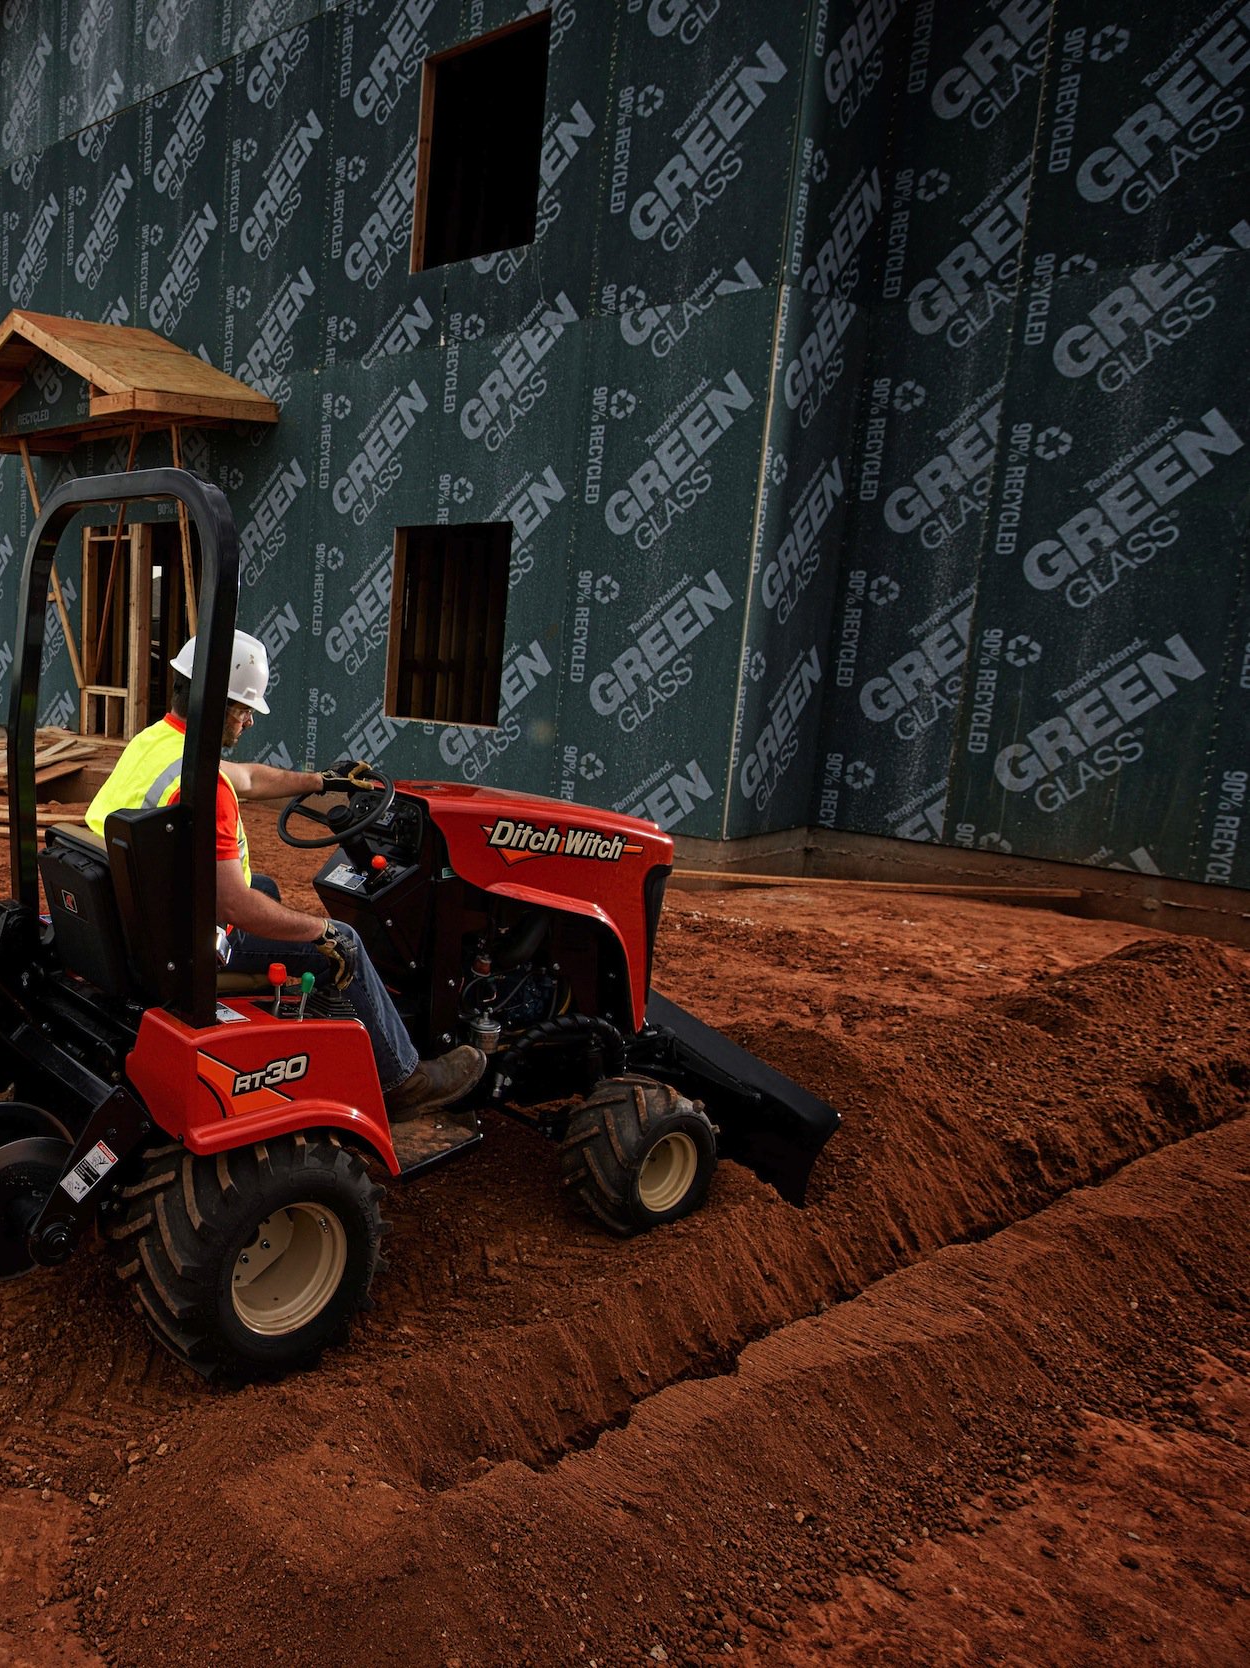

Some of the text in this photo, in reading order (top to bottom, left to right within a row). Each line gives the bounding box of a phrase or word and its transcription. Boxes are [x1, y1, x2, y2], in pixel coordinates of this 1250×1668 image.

[264, 27, 309, 110] GLASS
[340, 25, 354, 98] RECYCLED
[1049, 27, 1087, 174] 90% RECYCLED
[168, 127, 205, 200] GLASS
[229, 138, 241, 233] 90% RECYCLED
[240, 109, 324, 253] GREEN
[610, 86, 635, 214] 90% RECYCLED
[629, 40, 788, 241] GREEN
[1121, 94, 1245, 215] GLASS
[10, 193, 61, 303] GREEN
[74, 164, 134, 284] GREEN
[258, 185, 302, 261] GLASS
[331, 156, 346, 259] 90% RECYCLED
[661, 149, 743, 252] GLASS
[791, 137, 814, 276] 90% RECYCLED
[882, 168, 915, 299] 90% RECYCLED
[140, 250, 149, 310] RECYCLED
[149, 203, 218, 329] GREEN
[163, 268, 200, 337] GLASS
[327, 316, 338, 350] 90%
[459, 291, 580, 441] GREEN
[1096, 286, 1217, 393] GLASS
[16, 409, 50, 427] RECYCLED
[319, 393, 333, 489] 90% RECYCLED
[332, 379, 429, 515] GREEN
[484, 369, 547, 451] GLASS
[585, 386, 608, 504] 90% RECYCLED
[605, 368, 754, 535] GREEN
[860, 378, 891, 501] 90% RECYCLED
[352, 454, 403, 526] GLASS
[438, 473, 451, 510] 90%
[634, 465, 712, 550] GLASS
[761, 455, 845, 609] GREEN
[995, 423, 1033, 555] 90% RECYCLED
[1023, 407, 1245, 591] GREEN
[244, 524, 287, 587] GLASS
[312, 543, 326, 637] 90% RECYCLED
[777, 545, 821, 624] GLASS
[1065, 515, 1180, 608] GLASS
[570, 570, 592, 683] 90% RECYCLED
[589, 569, 734, 716] GREEN
[837, 569, 867, 688] 90% RECYCLED
[309, 687, 319, 713] 90%
[618, 656, 693, 733] GLASS
[741, 645, 823, 799] GREEN
[967, 629, 1003, 754] 90% RECYCLED
[994, 633, 1206, 792] GREEN
[461, 719, 522, 782] GLASS
[563, 745, 578, 778] 90%
[756, 730, 799, 811] GLASS
[824, 753, 844, 787] 90%
[1034, 731, 1144, 813] GLASS
[1217, 770, 1248, 811] 90%
[490, 820, 625, 860] Ditch Witch
[234, 1055, 308, 1094] RT30
